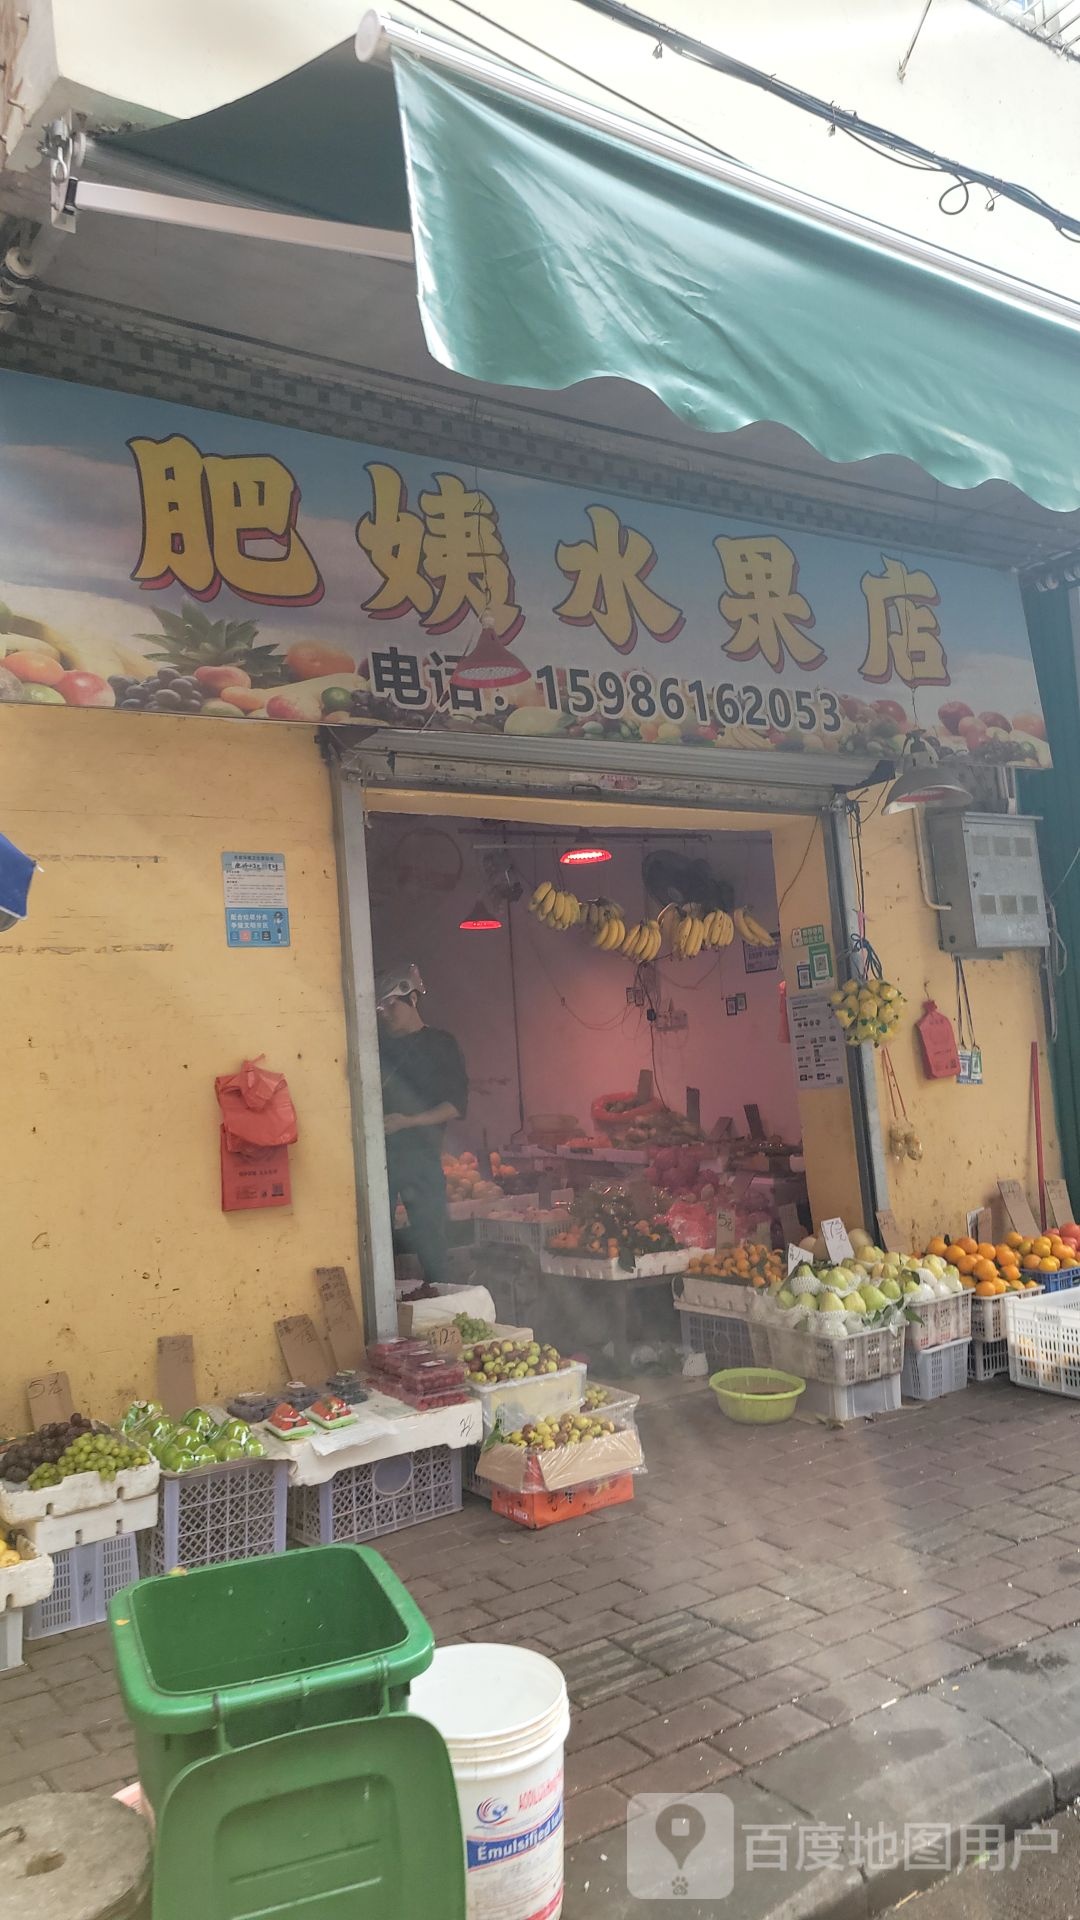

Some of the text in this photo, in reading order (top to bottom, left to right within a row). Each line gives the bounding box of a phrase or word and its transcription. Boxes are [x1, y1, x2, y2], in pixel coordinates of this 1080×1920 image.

[126, 433, 951, 688] 肥姨水果店
